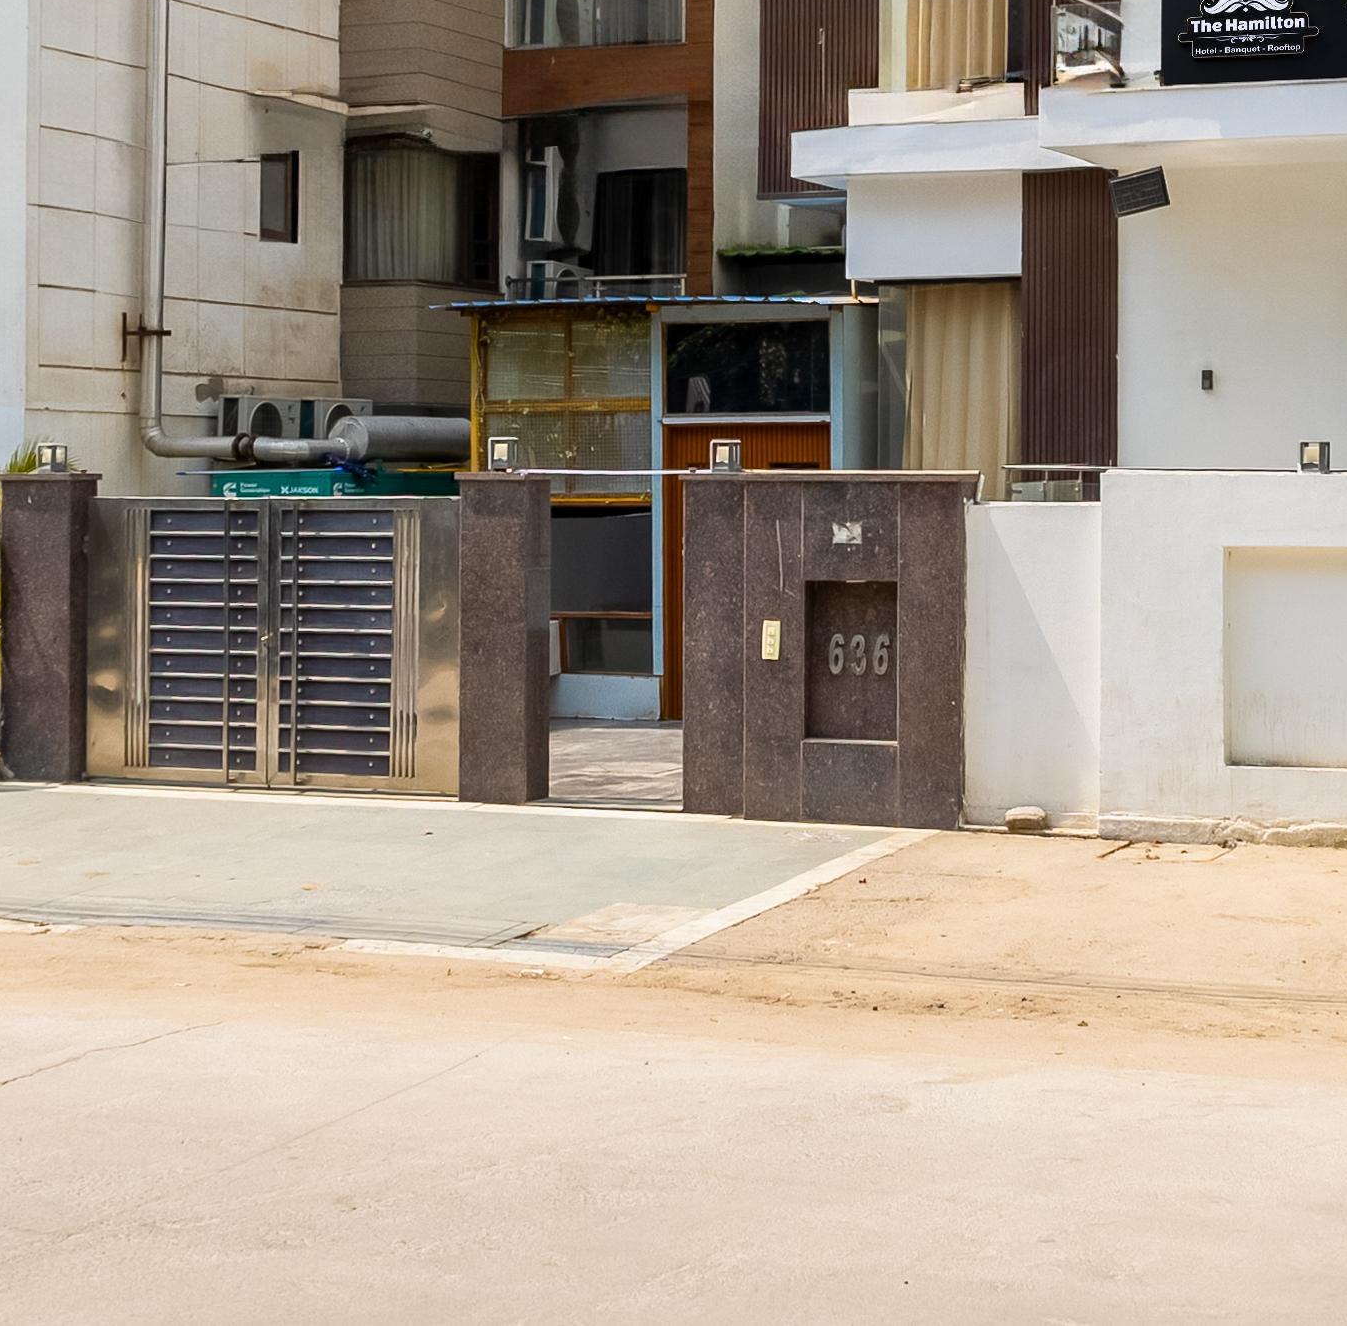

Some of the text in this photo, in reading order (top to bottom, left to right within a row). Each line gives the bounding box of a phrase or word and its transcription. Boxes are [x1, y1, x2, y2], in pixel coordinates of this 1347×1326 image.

[1191, 15, 1305, 33] The Hamilton
[1195, 46, 1217, 55] Hotel
[1224, 45, 1261, 54] Banquet
[1267, 43, 1301, 52] Rooftop
[289, 486, 319, 494] JAKSON
[828, 633, 890, 676] 636
